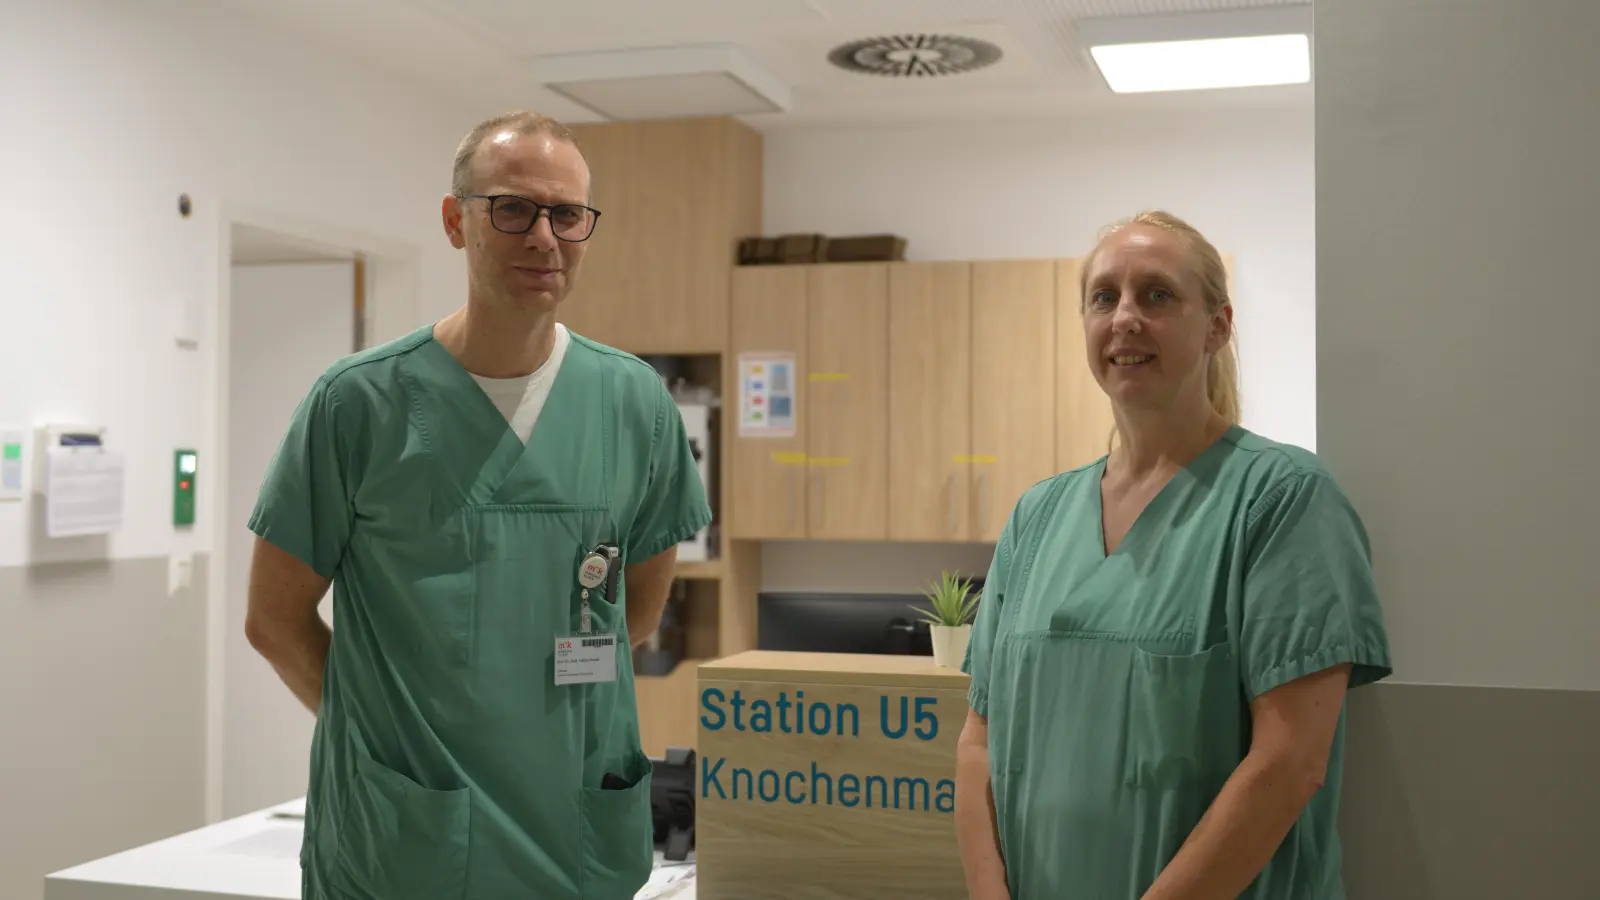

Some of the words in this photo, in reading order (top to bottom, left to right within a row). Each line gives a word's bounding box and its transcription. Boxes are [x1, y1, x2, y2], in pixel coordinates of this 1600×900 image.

[700, 687, 859, 738] Station
[879, 695, 939, 741] U5
[701, 756, 955, 813] Knochenma
